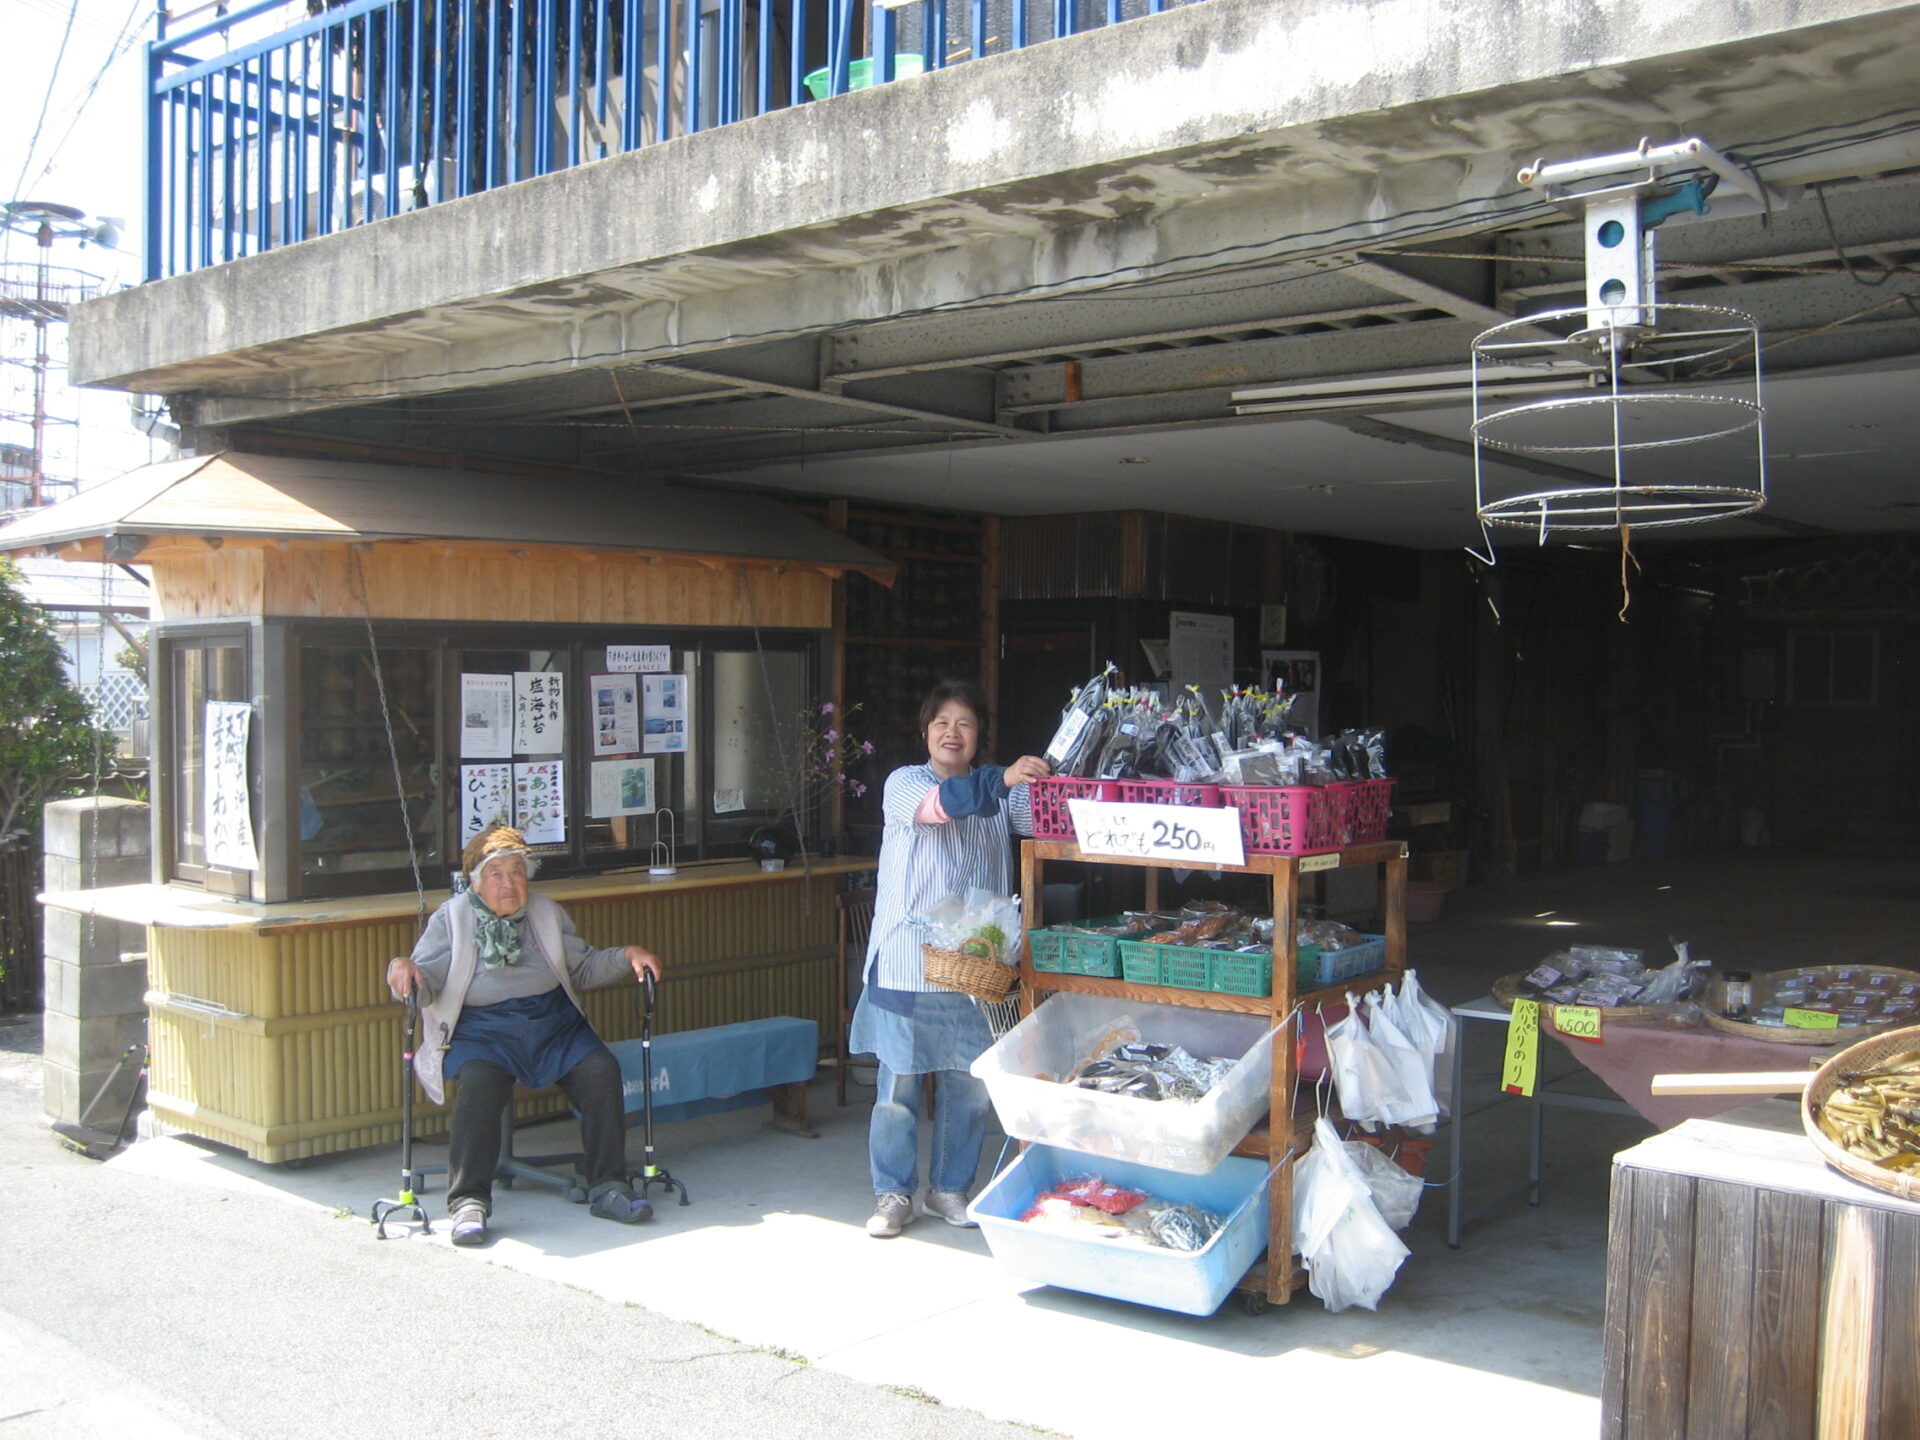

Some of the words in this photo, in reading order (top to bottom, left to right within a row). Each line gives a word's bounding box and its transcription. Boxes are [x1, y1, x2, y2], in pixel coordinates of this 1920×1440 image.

[529, 677, 545, 734] 塩海苔
[225, 713, 237, 764] 天然
[526, 765, 549, 775] 天然
[468, 778, 487, 832] ひじき
[1513, 1003, 1534, 1084] パリパリのり
